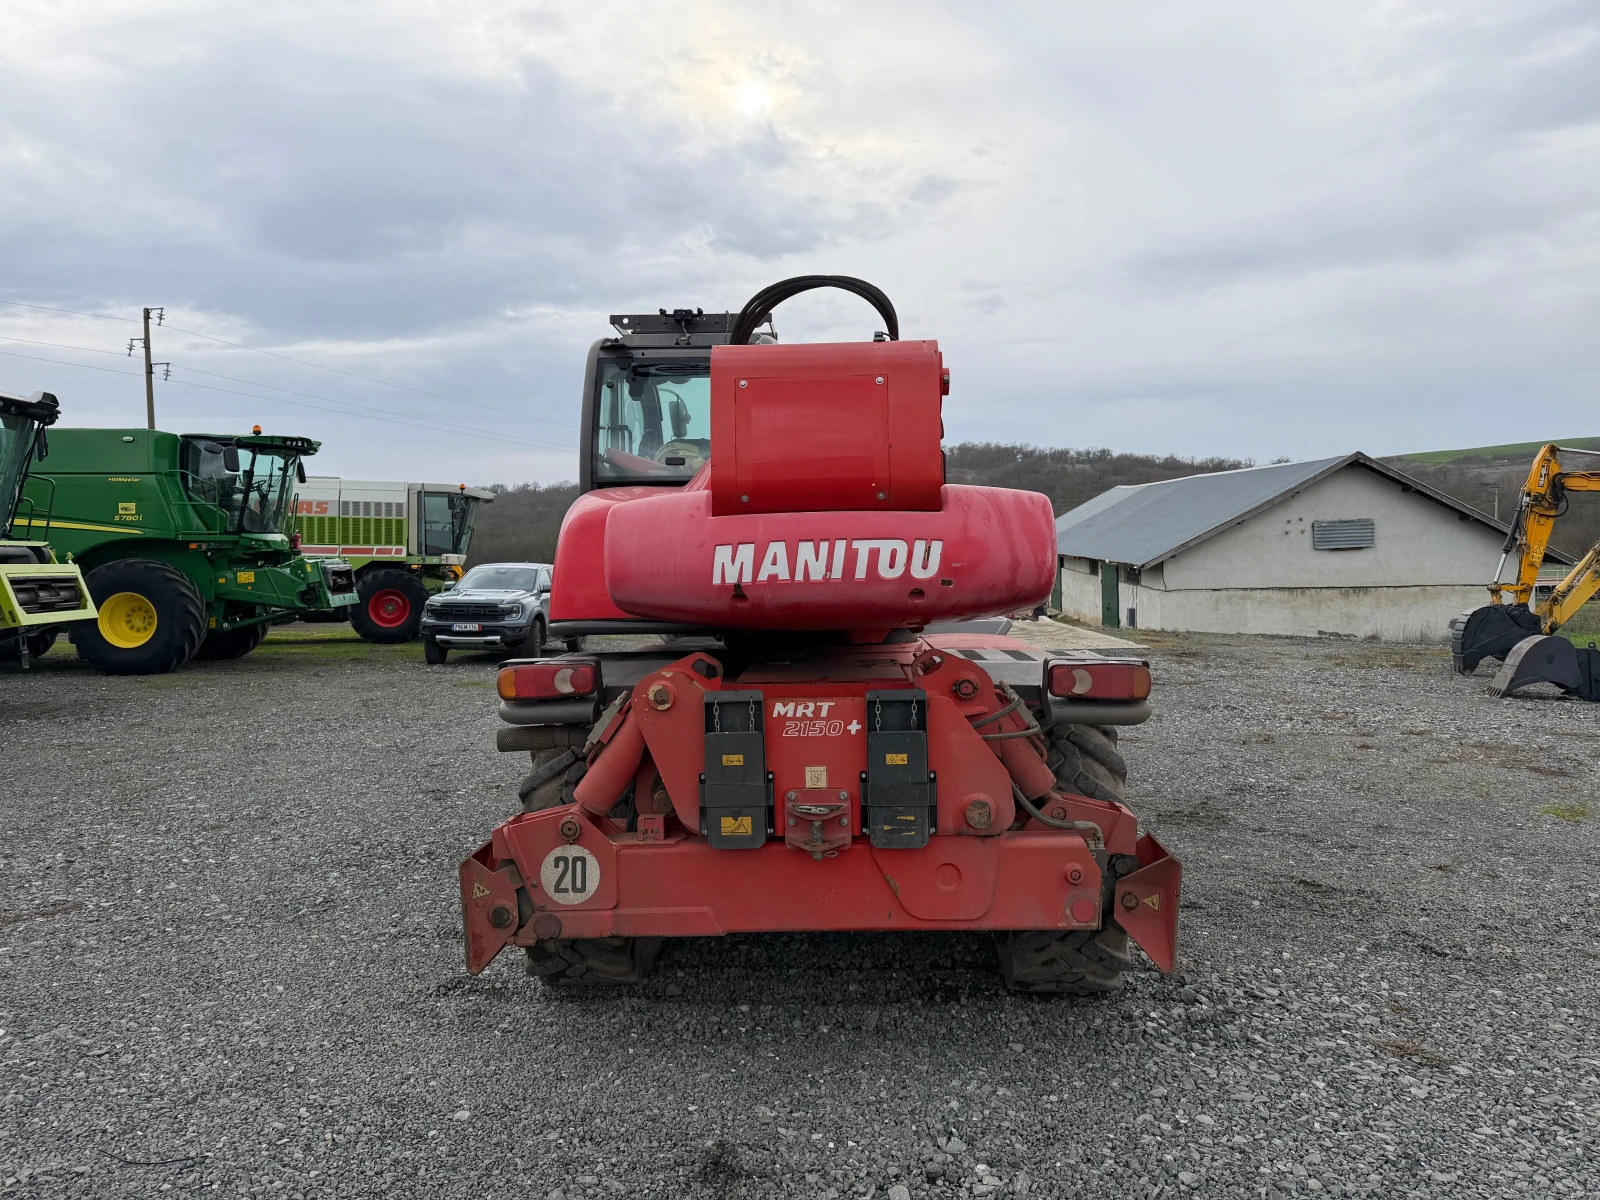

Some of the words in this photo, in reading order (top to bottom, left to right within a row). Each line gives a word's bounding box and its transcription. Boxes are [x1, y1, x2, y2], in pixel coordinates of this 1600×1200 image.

[712, 538, 944, 585] MANITOU
[772, 701, 836, 718] MRT
[553, 855, 587, 894] 20
